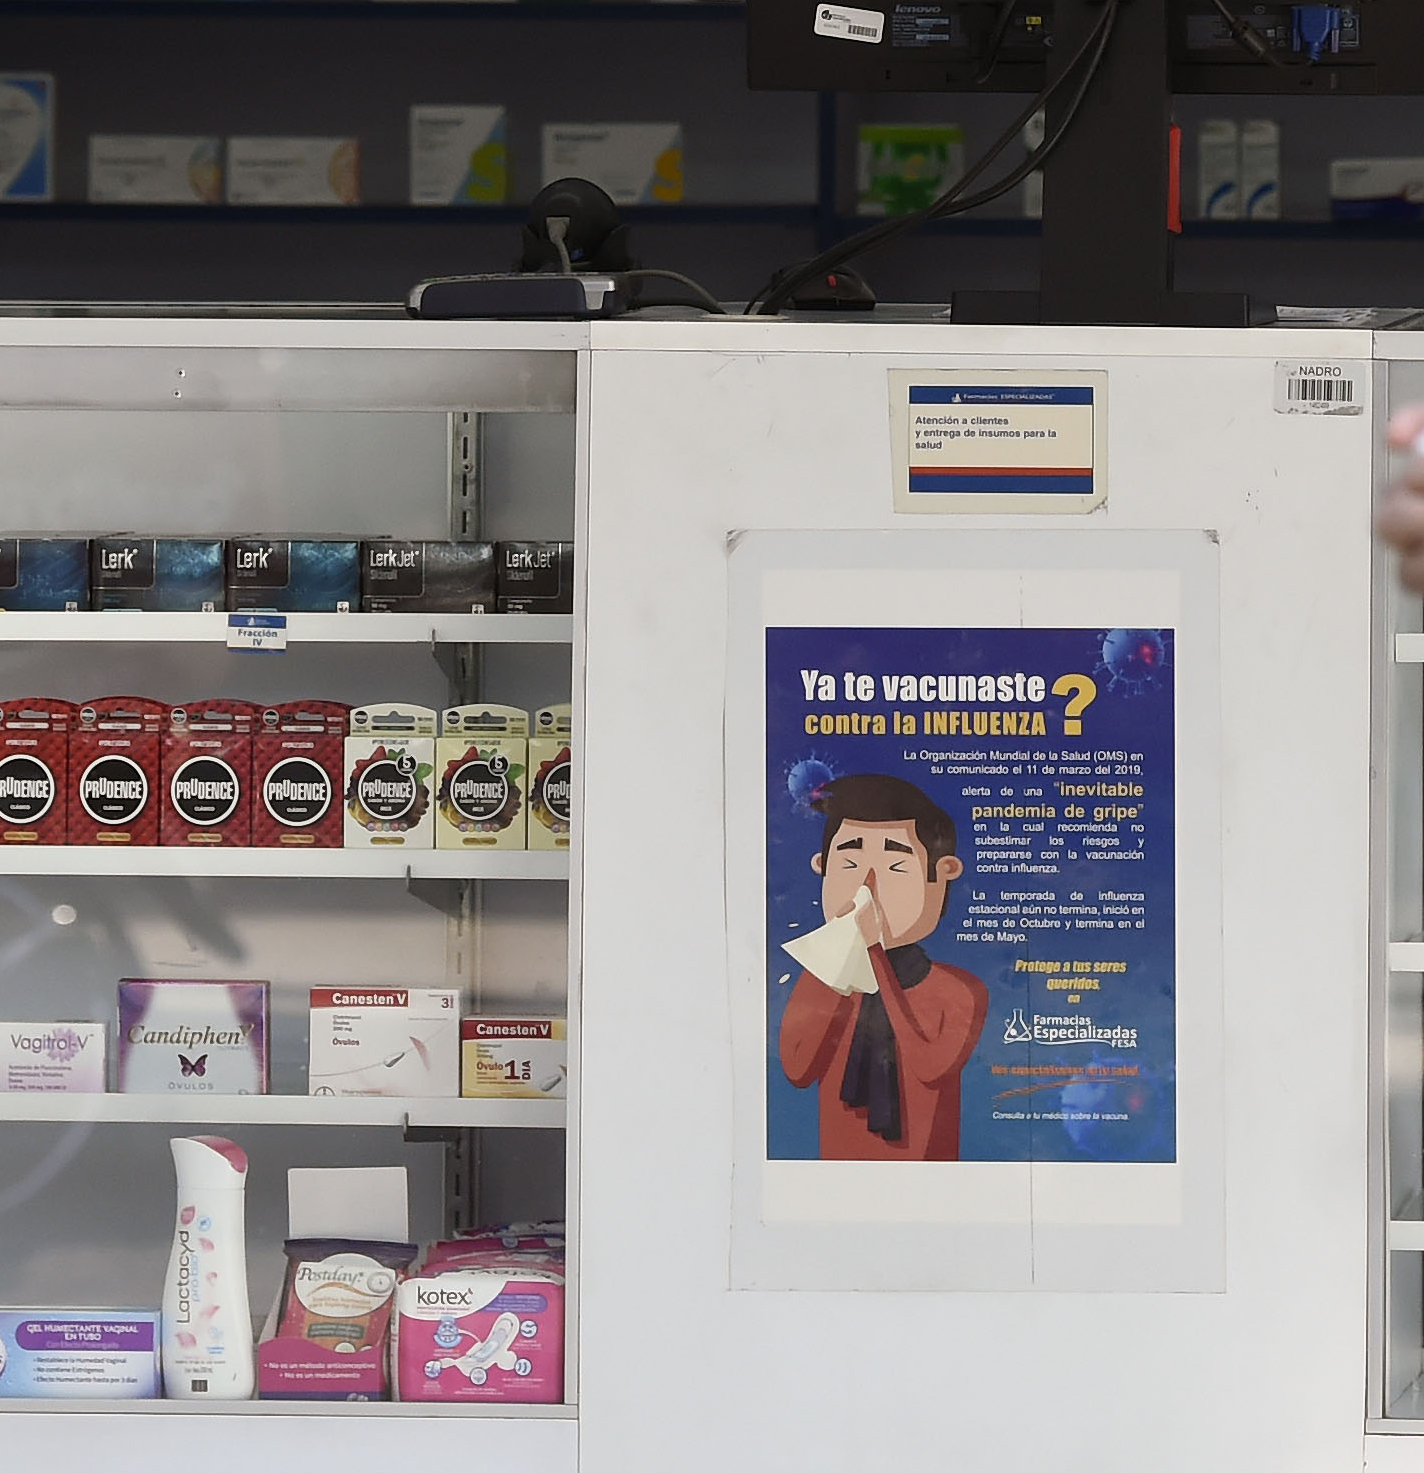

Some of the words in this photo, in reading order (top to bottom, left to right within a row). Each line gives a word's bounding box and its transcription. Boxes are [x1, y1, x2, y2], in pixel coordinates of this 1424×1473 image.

[1299, 365, 1342, 377] NADRO
[915, 415, 958, 426] Atención
[962, 417, 968, 426] a
[970, 415, 1009, 426] clientes
[915, 430, 921, 439] y
[924, 429, 961, 440] entrega
[963, 428, 976, 438] de
[978, 428, 1020, 438] insumos
[1023, 430, 1045, 440] para
[1047, 428, 1057, 438] la
[915, 439, 943, 451] salud
[237, 627, 277, 639] Fracción
[253, 639, 263, 648] IV
[801, 670, 835, 701] Ya
[844, 674, 875, 702] te
[883, 672, 1046, 702] vacunaste
[1051, 673, 1097, 736] ?
[804, 711, 886, 735] contra
[893, 711, 916, 735] la
[923, 711, 1047, 735] INFLUENZA
[903, 751, 917, 762] La
[919, 751, 987, 763] Organización
[989, 751, 1031, 762] Mundial
[1032, 751, 1047, 762] de
[1048, 751, 1059, 762] la
[1060, 751, 1091, 762] Salud
[1092, 751, 1128, 763] (OMS)
[1130, 751, 1144, 762] en
[930, 765, 944, 775] su
[946, 765, 1010, 775] comunicado
[1012, 765, 1023, 775] el
[1026, 765, 1037, 775] 11
[1041, 765, 1056, 775] de
[1058, 765, 1092, 775] marzo
[1094, 765, 1111, 775] del
[1114, 765, 1144, 776] 2019,
[961, 786, 991, 797] alerta
[1000, 786, 1014, 797] de
[1023, 786, 1043, 797] una
[971, 802, 1056, 823] pandemia
[1063, 802, 1086, 818] de
[973, 823, 987, 832] en
[999, 823, 1010, 832] la
[1022, 823, 1045, 832] cual
[1057, 823, 1118, 832] recomienda
[1130, 823, 1145, 832] no
[974, 836, 1032, 846] subestimar
[1049, 836, 1065, 846] los
[1082, 836, 1121, 847] riesgos
[1137, 836, 1146, 847] y
[976, 850, 1033, 861] prepararse
[1040, 850, 1060, 859] con
[1067, 850, 1078, 859] la
[1085, 850, 1145, 859] vacunación
[976, 864, 1009, 873] contra
[1011, 864, 1061, 873] influenza.
[1015, 960, 1061, 973] Protege
[1062, 960, 1070, 973] a
[1072, 960, 1092, 973] tus
[1093, 960, 1127, 973] seres
[332, 992, 393, 1006] Canesten
[395, 992, 407, 1006] V
[1033, 1014, 1093, 1026] Farmacias
[128, 1024, 239, 1050] Candiphen
[1033, 1025, 1138, 1041] Especializadas
[10, 1034, 89, 1054] Vagitrol-V
[1111, 1040, 1138, 1049] FESA
[176, 1230, 195, 1325] Lactacyd
[416, 1284, 471, 1306] kotex
